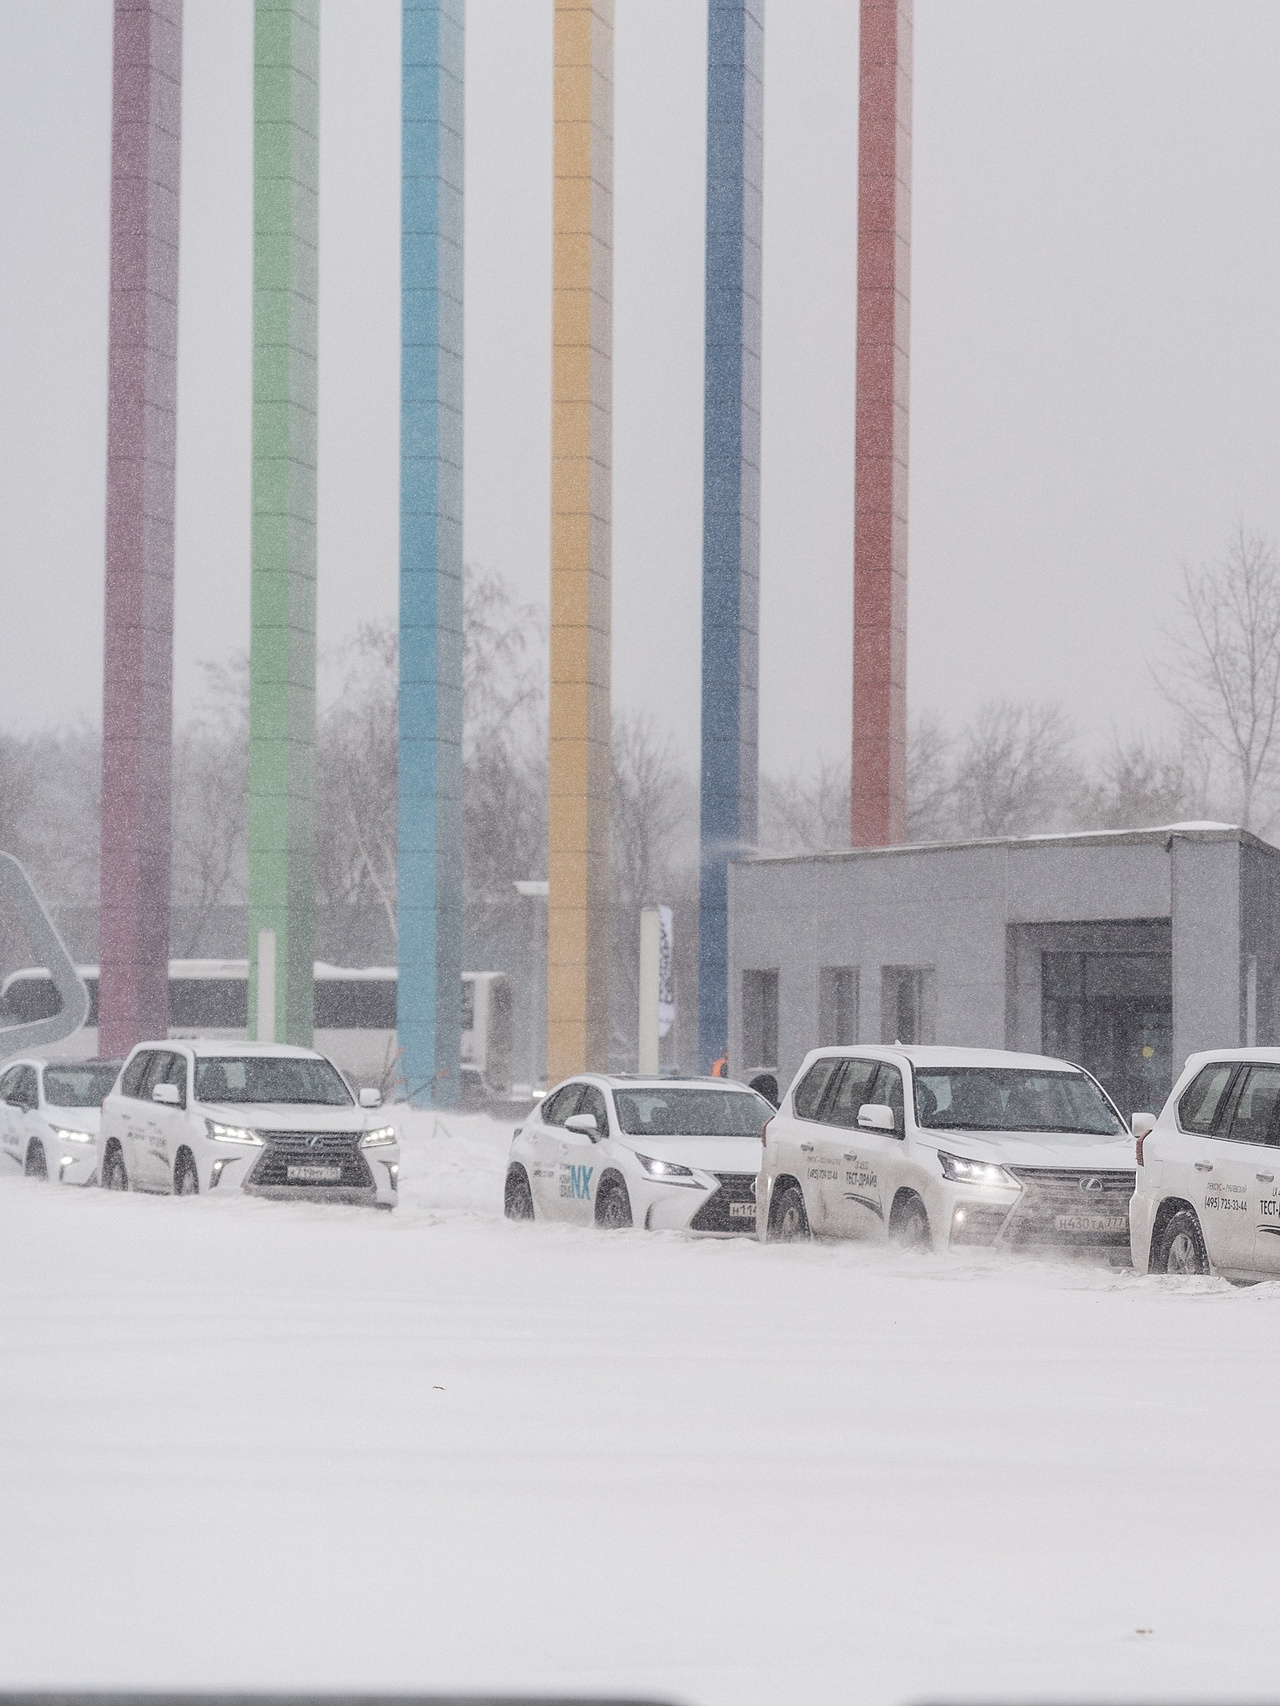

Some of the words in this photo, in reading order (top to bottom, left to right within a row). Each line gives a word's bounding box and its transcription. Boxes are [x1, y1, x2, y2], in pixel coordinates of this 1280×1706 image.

[571, 1165, 594, 1200] NX
[1205, 1196, 1219, 1210] (495)
[1220, 1198, 1247, 1211] 725-33-44
